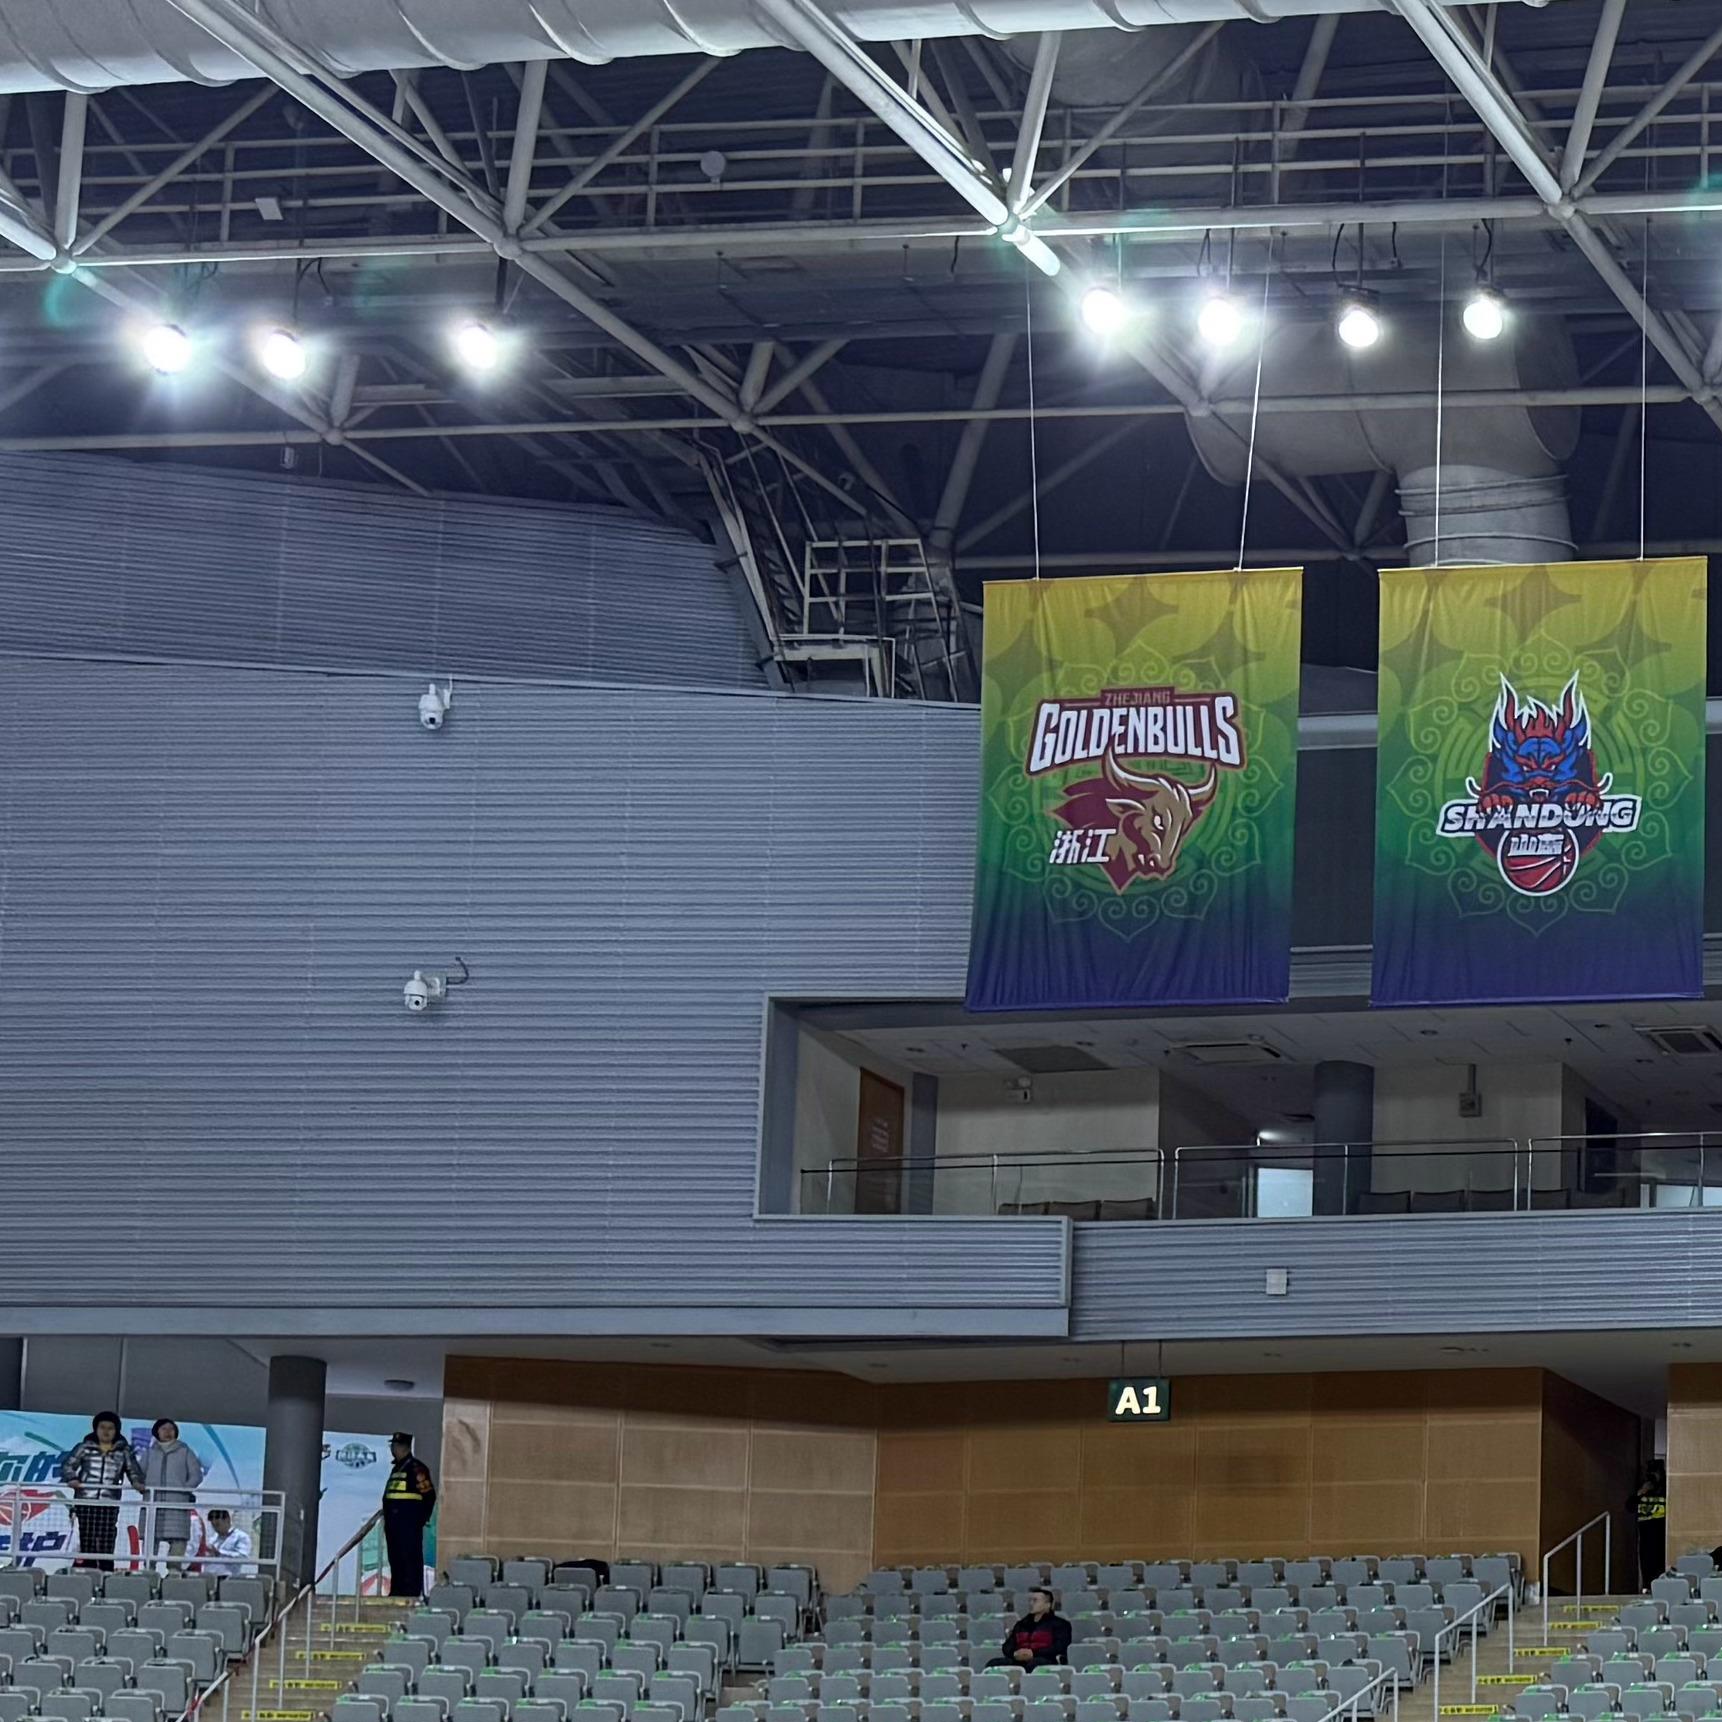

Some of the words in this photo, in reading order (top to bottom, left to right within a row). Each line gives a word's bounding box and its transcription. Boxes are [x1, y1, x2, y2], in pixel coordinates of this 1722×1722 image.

[1104, 691, 1171, 706] ZHEJIANG
[1029, 695, 1241, 774] GOLDENBULLS
[1443, 799, 1635, 831] SHANDONG
[1049, 828, 1117, 864] 浙江
[1115, 1386, 1161, 1415] A1
